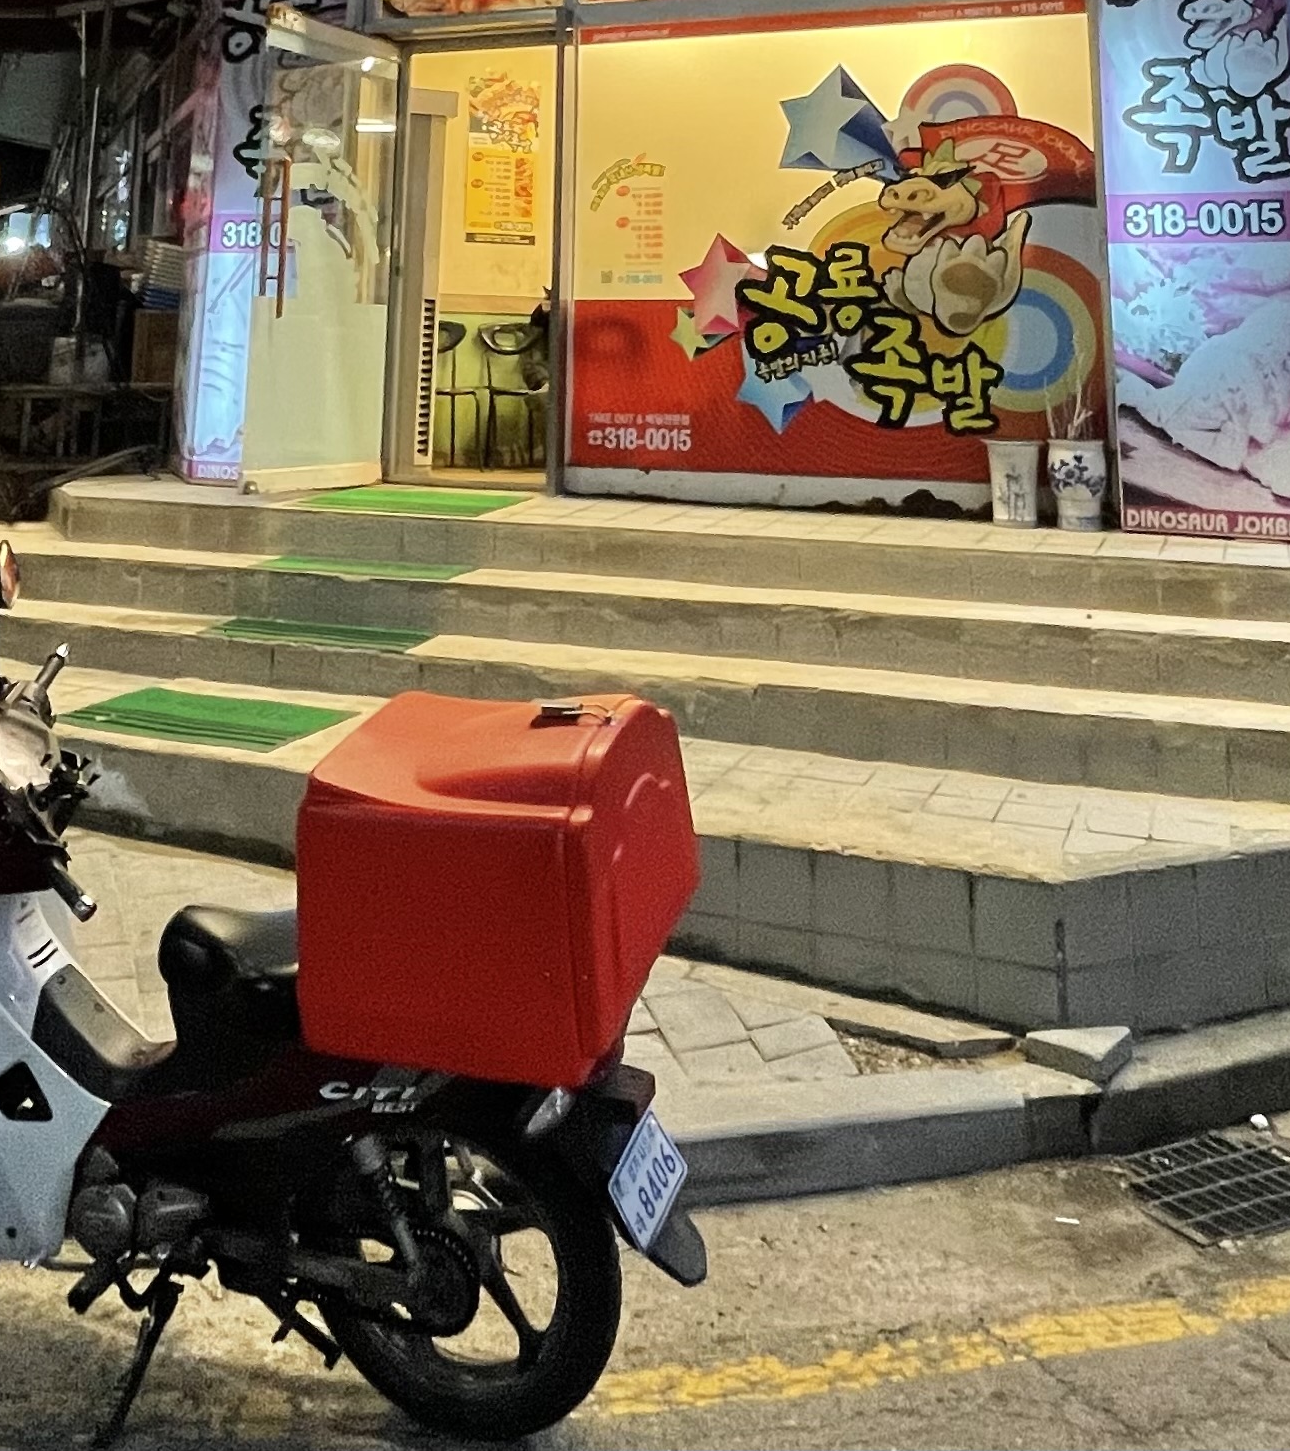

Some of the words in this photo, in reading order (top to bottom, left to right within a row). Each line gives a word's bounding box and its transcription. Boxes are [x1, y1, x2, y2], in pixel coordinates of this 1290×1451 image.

[1125, 201, 1285, 238] 318-0015
[735, 242, 887, 357] 공룡
[843, 308, 1004, 436] 족발
[604, 426, 692, 451] 318-0015
[1126, 509, 1228, 532] DINOSAUR
[637, 1142, 677, 1220] 8406
